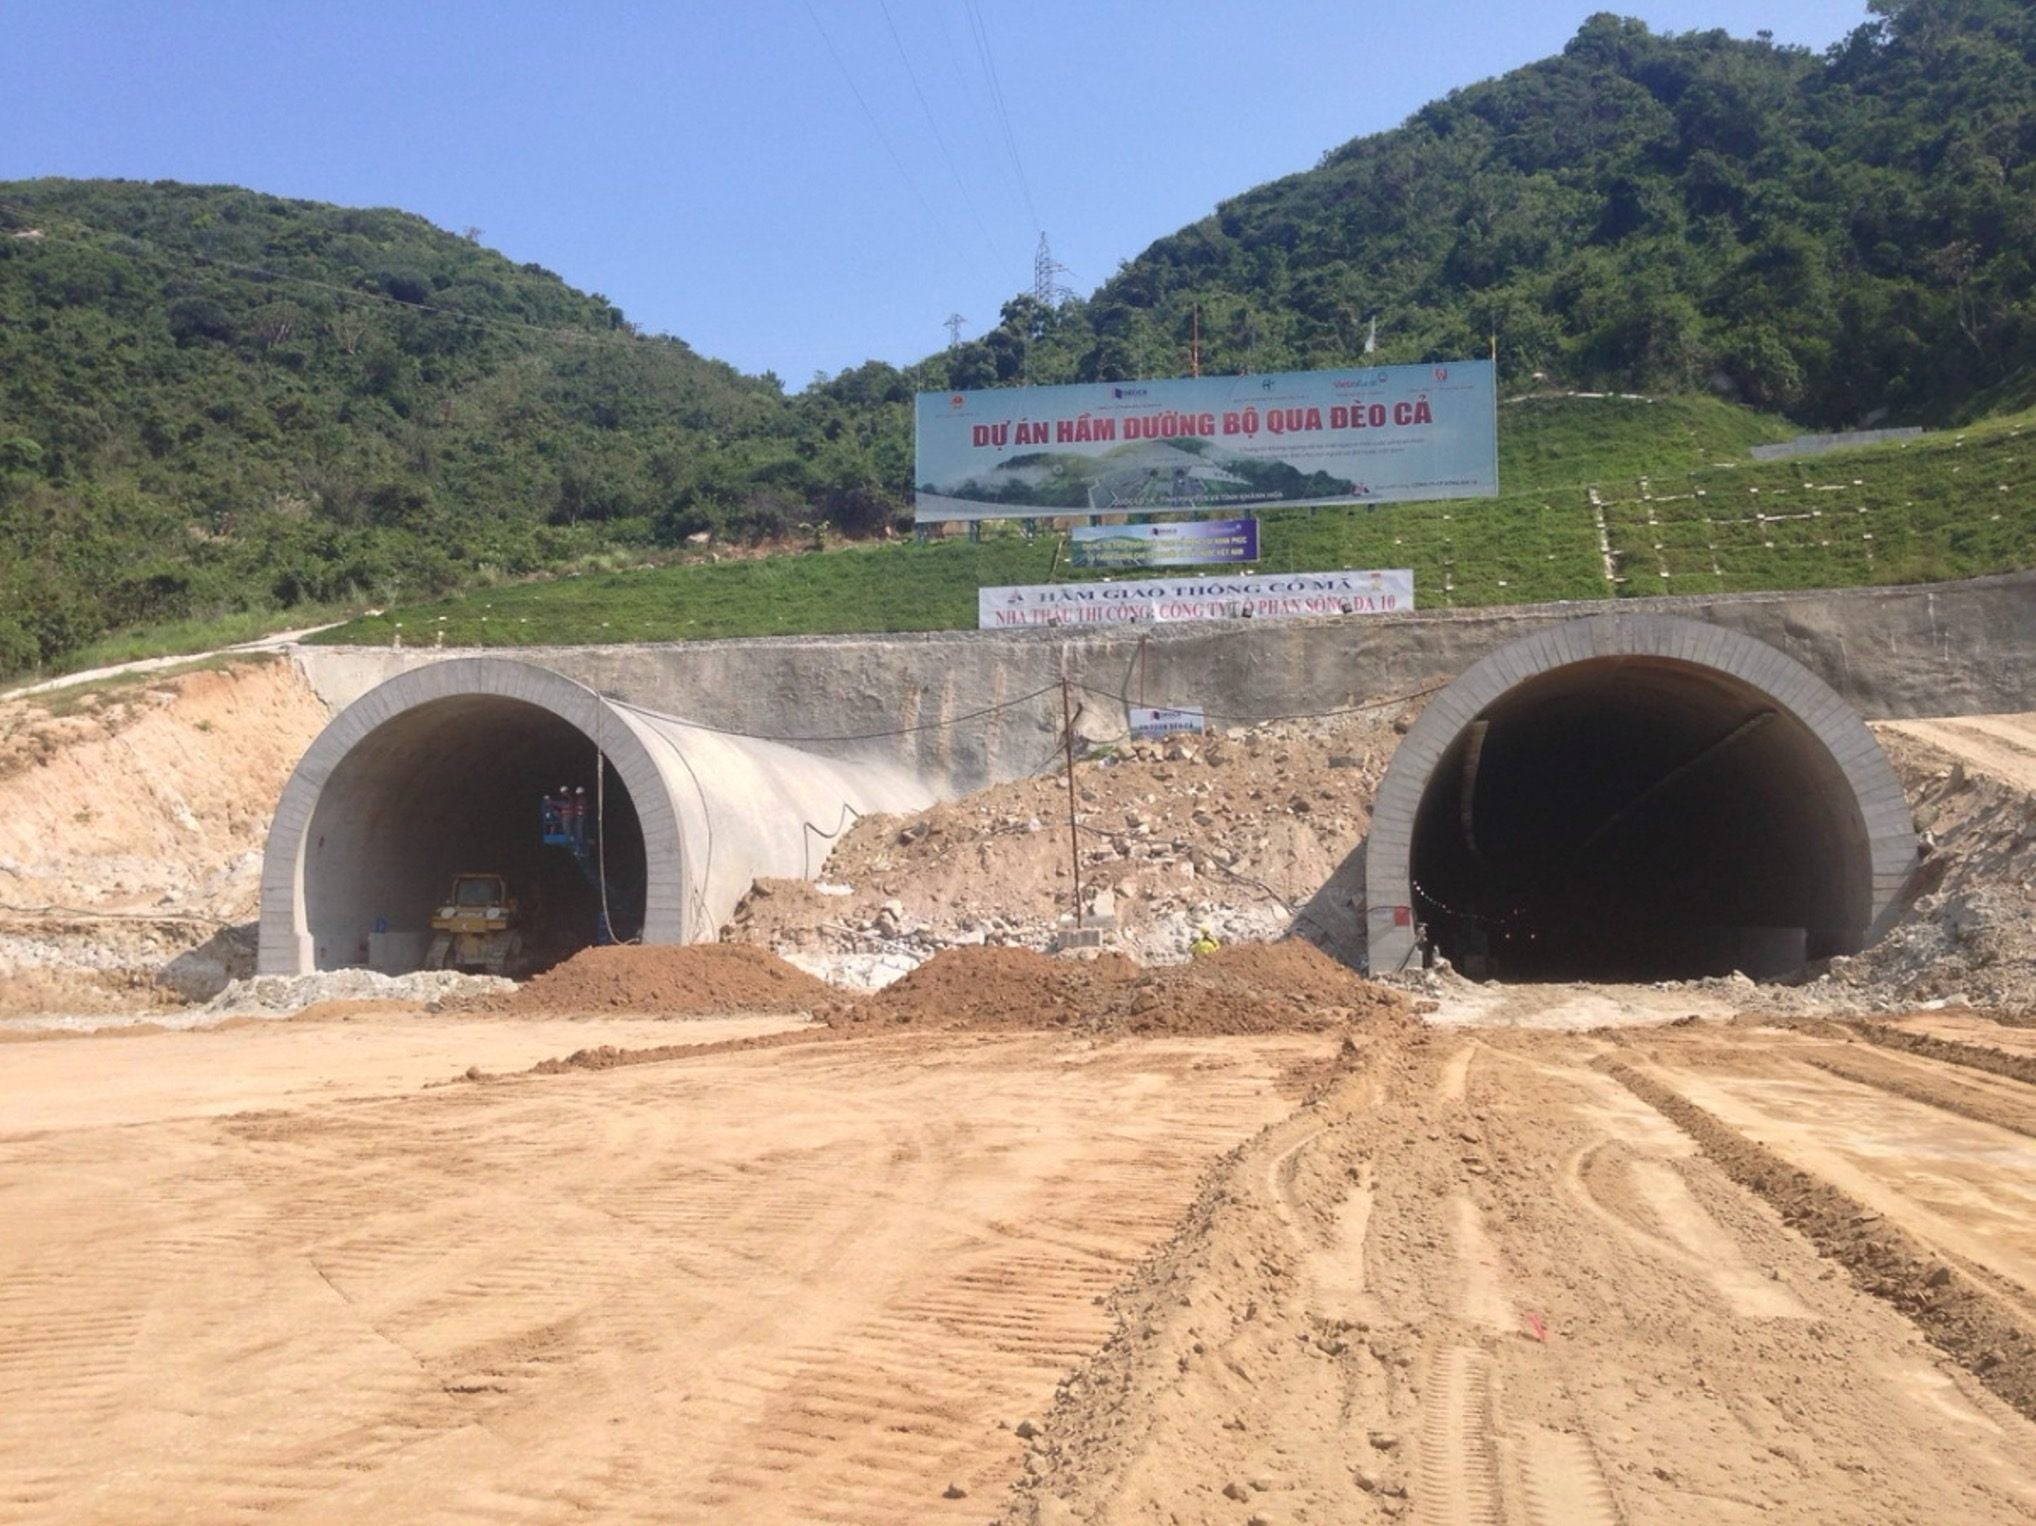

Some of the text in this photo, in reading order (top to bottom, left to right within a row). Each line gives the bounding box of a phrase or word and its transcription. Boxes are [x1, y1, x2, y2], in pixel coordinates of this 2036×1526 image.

[973, 394, 1433, 451] DỰ ÁN HẦM ĐƯỜNG BỘ QUA ĐÈO CẢ
[1103, 587, 1165, 600] GIAO
[1171, 582, 1261, 597] THÔNG
[1313, 577, 1352, 590] MÃ
[1076, 606, 1102, 622] THI
[1207, 601, 1226, 618] TY
[1382, 594, 1396, 611] 10
